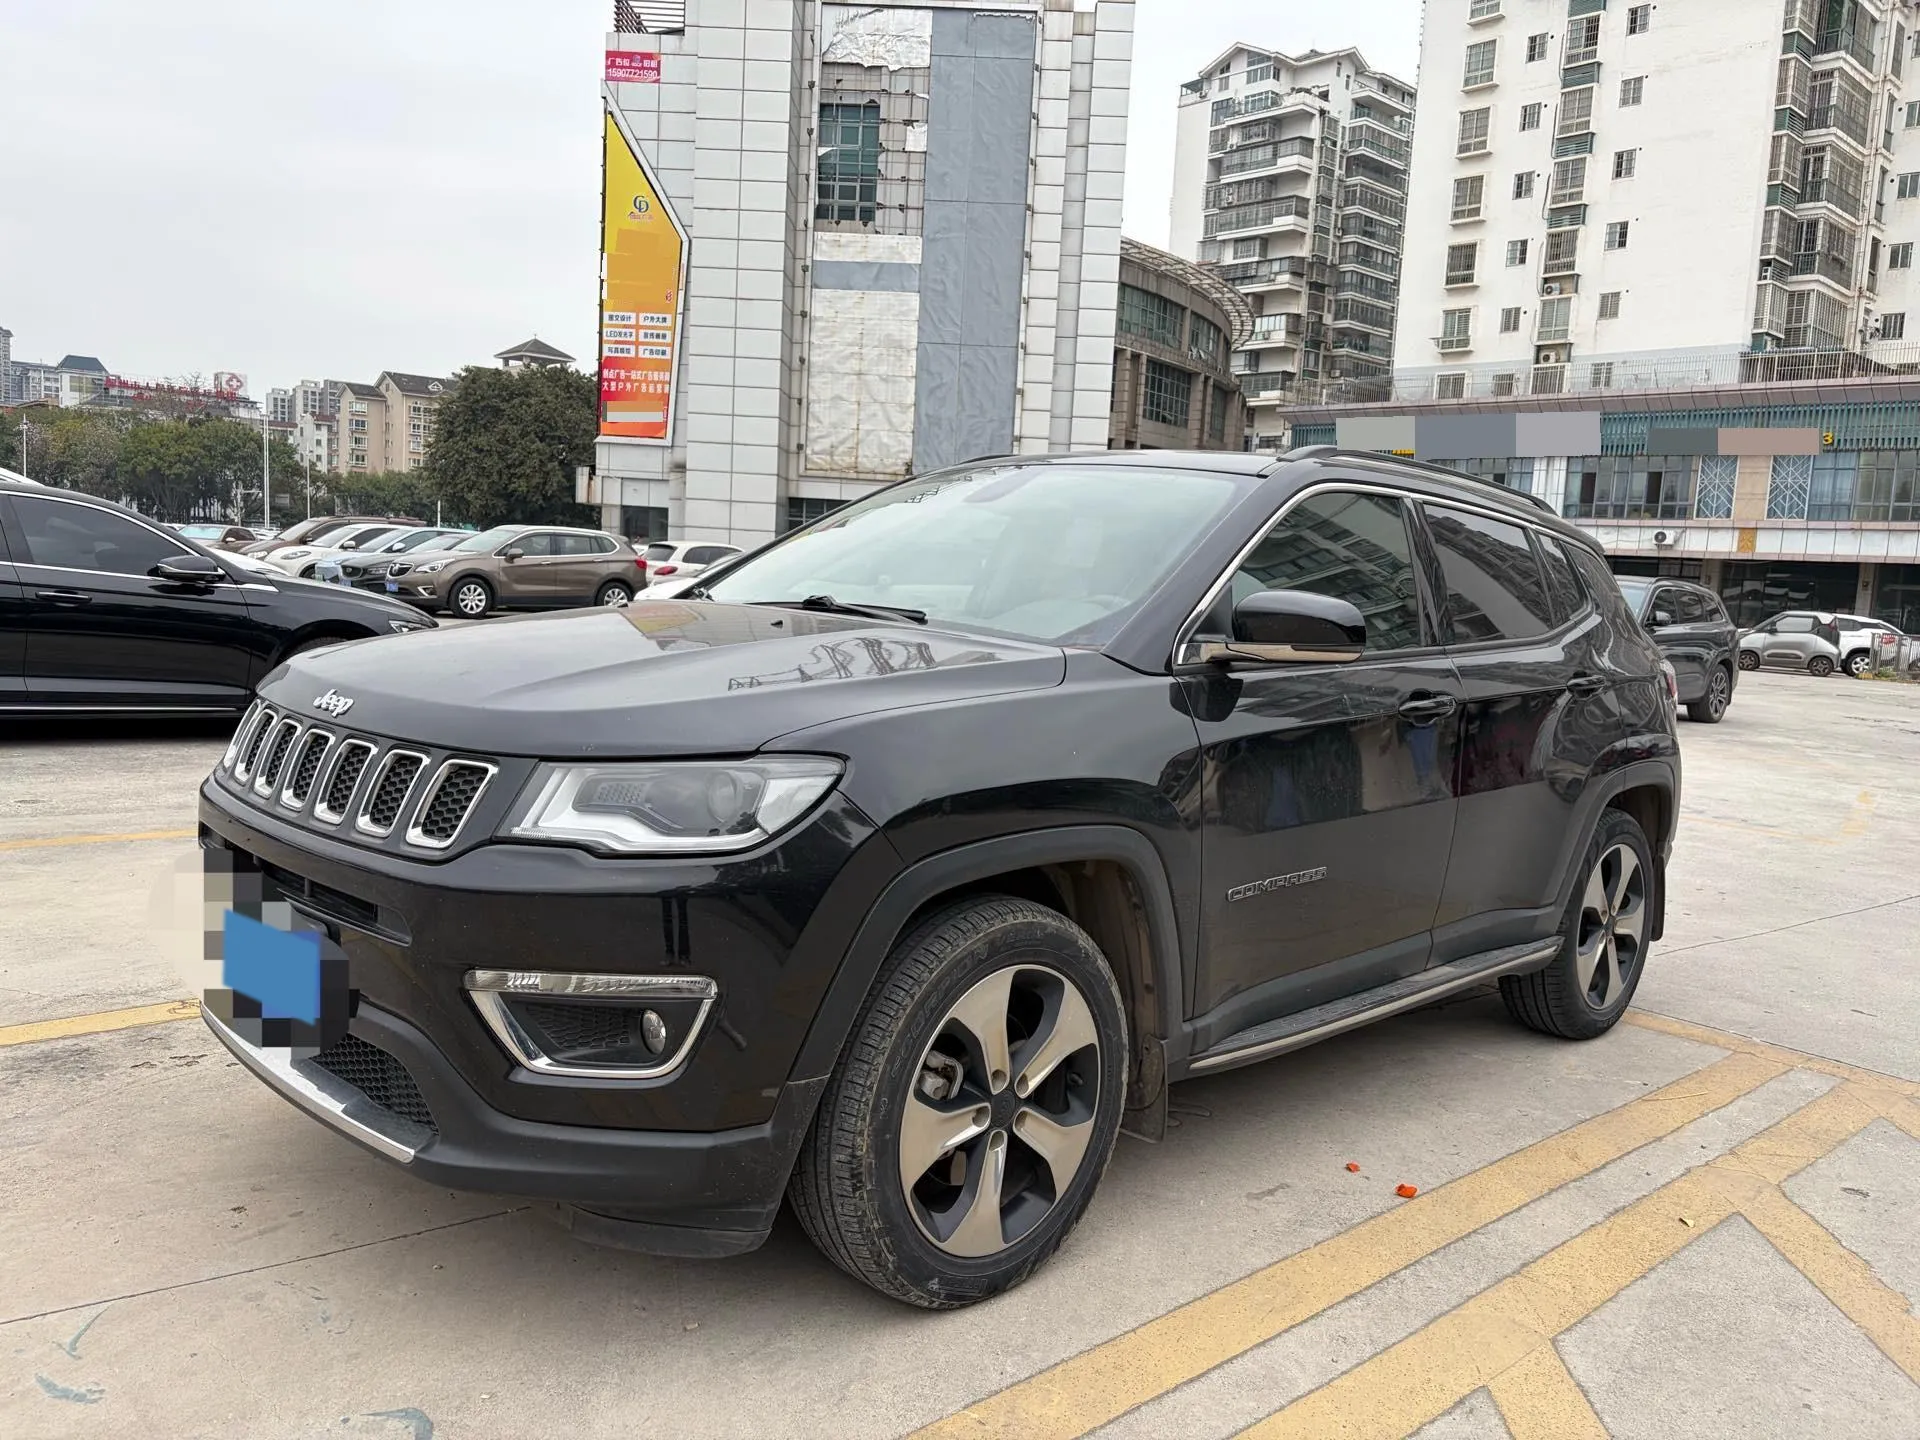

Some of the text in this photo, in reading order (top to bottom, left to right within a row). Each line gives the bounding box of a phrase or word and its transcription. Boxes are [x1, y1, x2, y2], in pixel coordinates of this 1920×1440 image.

[607, 67, 658, 79] 15907721590
[605, 330, 633, 339] LED发光字
[313, 689, 354, 718] Jeep
[1227, 866, 1327, 901] COMPASS
